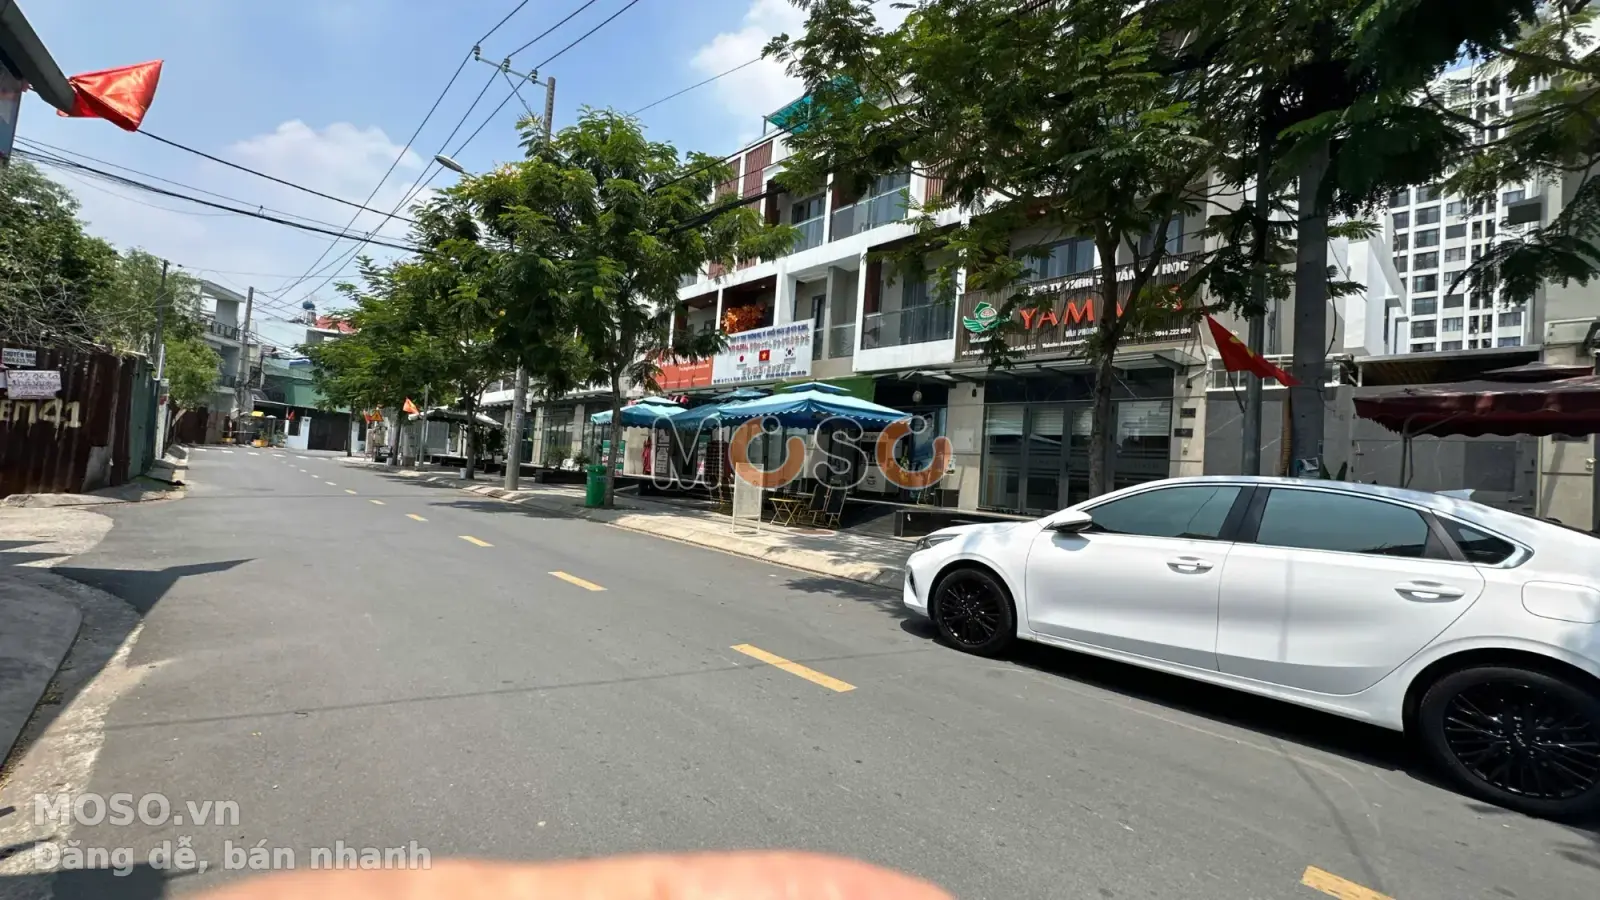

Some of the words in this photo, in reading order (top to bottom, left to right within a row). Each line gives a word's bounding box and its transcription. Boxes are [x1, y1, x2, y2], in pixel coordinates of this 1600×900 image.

[1050, 282, 1062, 292] TY
[1065, 278, 1093, 290] TNHH
[1162, 261, 1189, 275] HỌC
[1019, 298, 1095, 330] YAM
